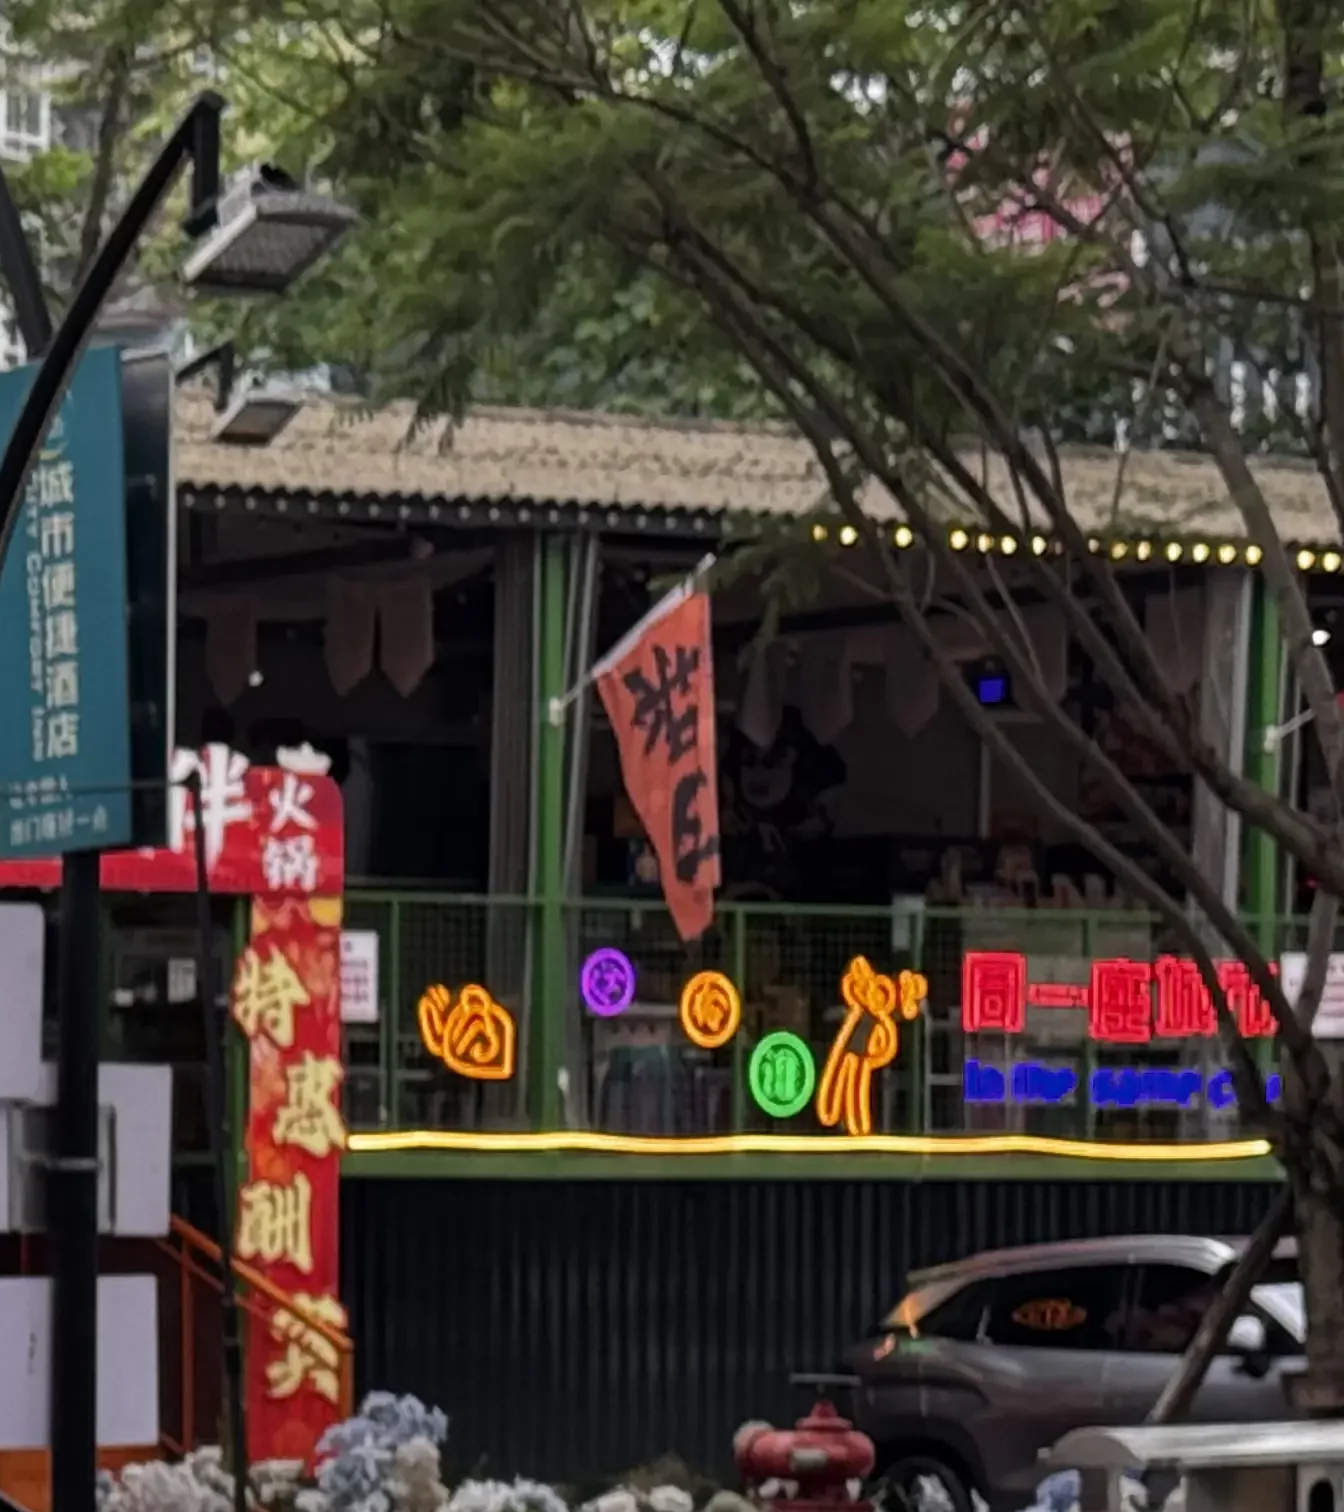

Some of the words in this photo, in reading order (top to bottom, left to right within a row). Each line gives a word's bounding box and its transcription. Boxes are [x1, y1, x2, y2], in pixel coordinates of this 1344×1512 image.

[39, 459, 80, 760] 城市便捷酒店
[262, 772, 320, 894] 火锅
[230, 943, 347, 1403] 特惠酬宾
